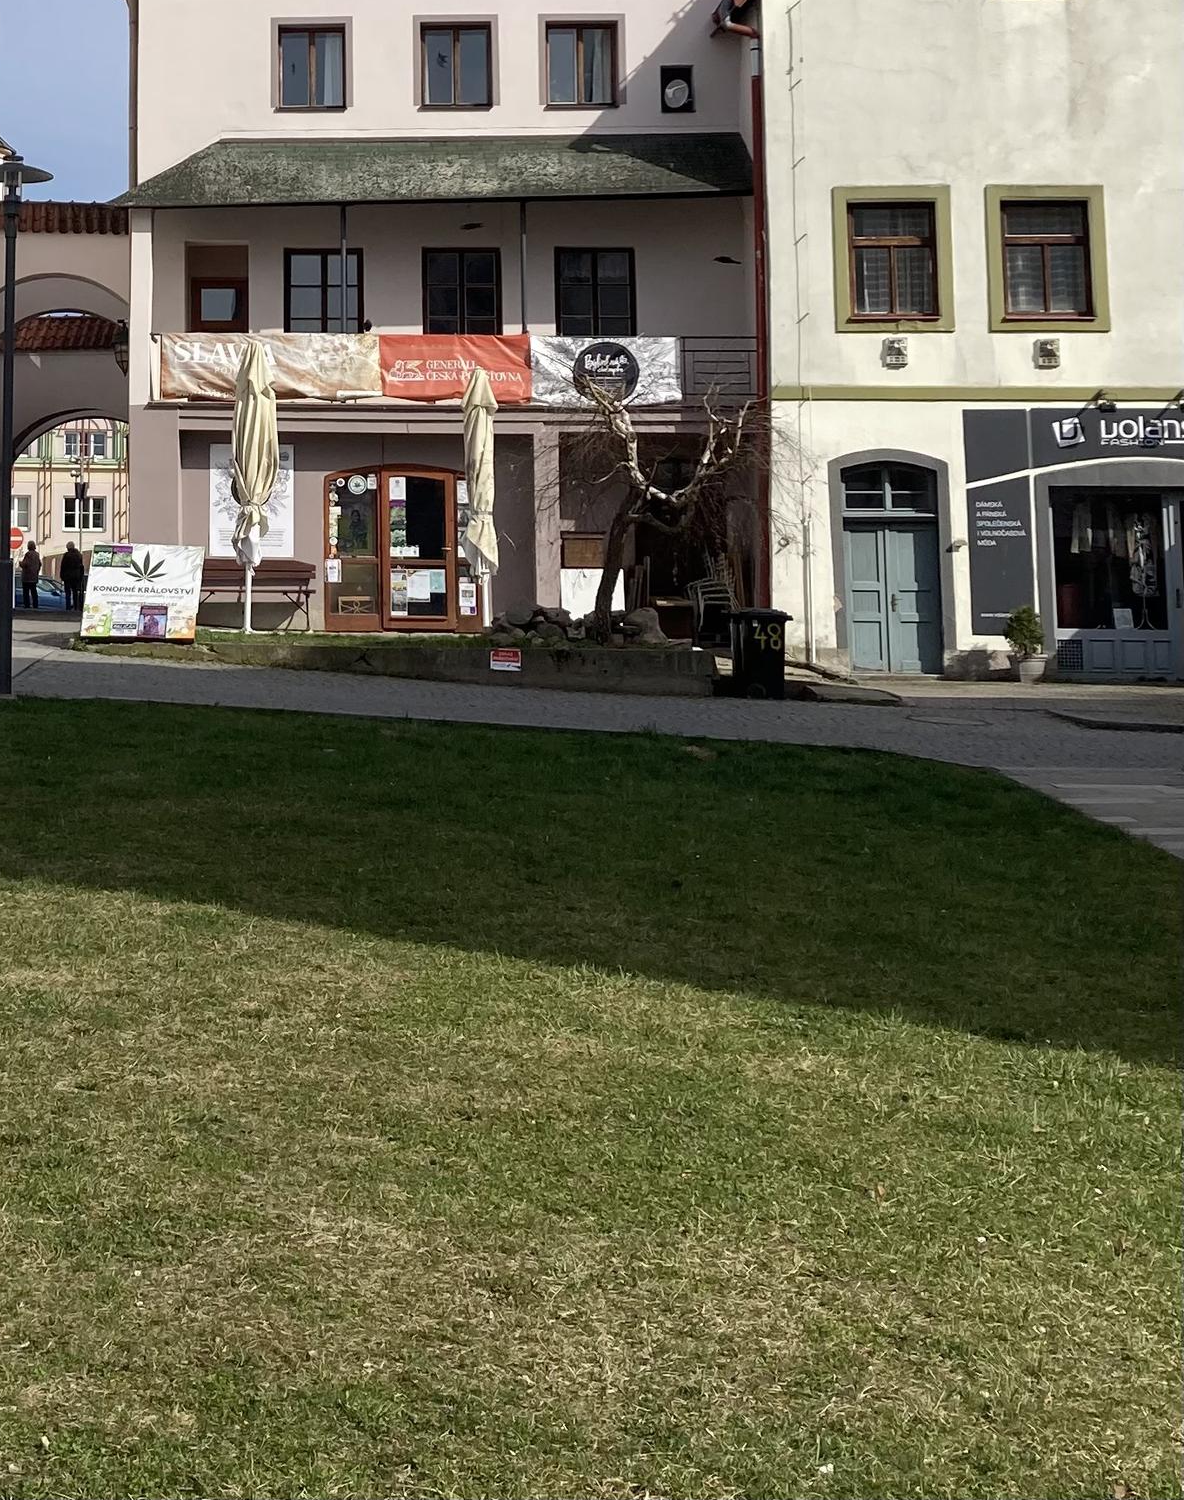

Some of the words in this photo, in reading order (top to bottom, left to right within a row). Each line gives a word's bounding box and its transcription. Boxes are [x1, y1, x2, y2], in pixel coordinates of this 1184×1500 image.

[173, 341, 277, 366] SLAVA
[426, 360, 476, 370] GENERALI
[93, 585, 136, 593] KONOPNÉ
[137, 586, 194, 595] KRÁLOVSTVÍ
[753, 623, 781, 650] 48
